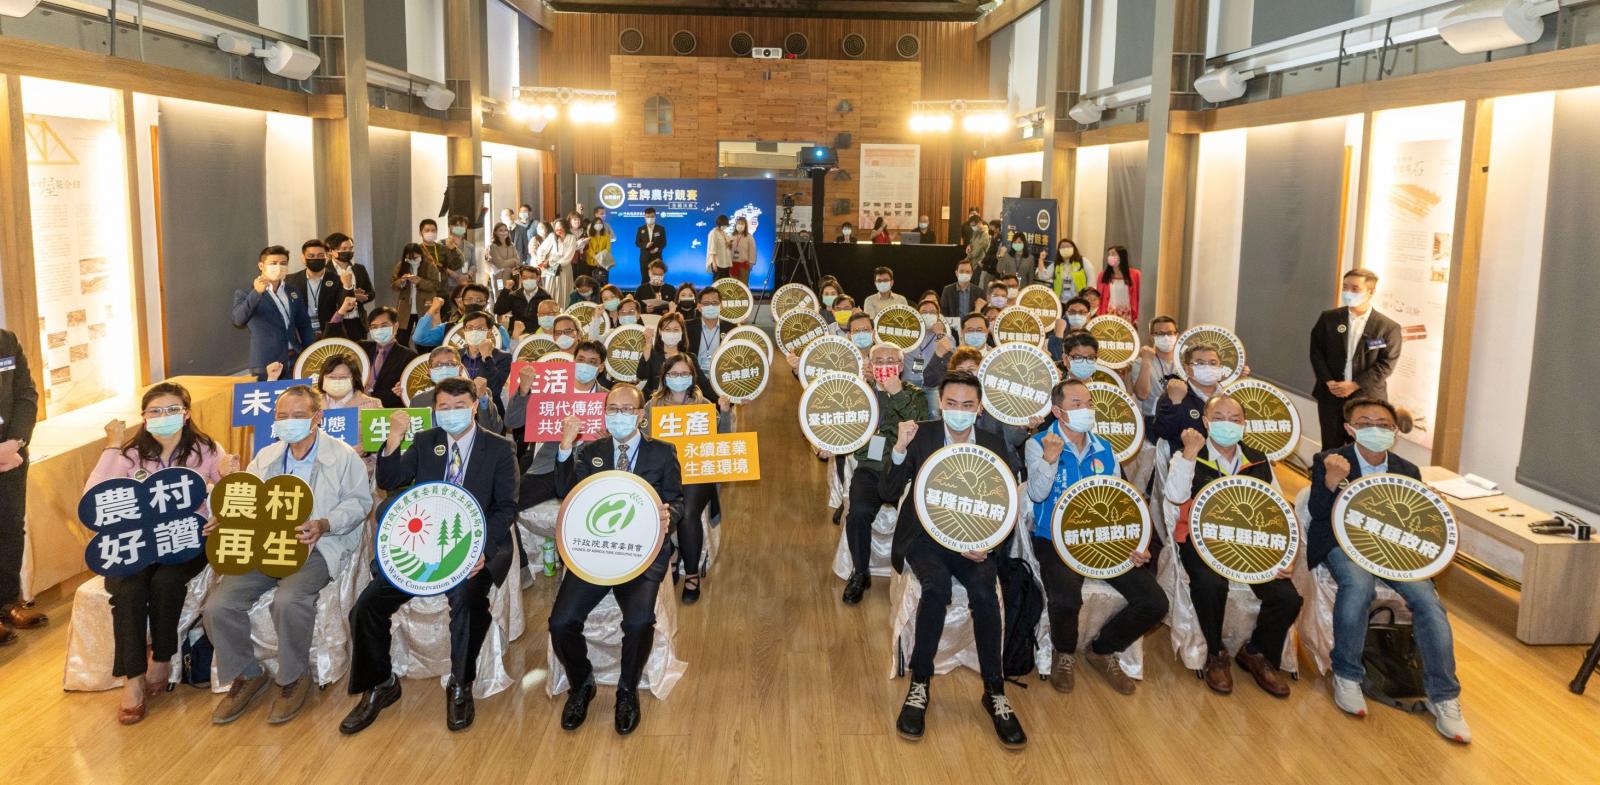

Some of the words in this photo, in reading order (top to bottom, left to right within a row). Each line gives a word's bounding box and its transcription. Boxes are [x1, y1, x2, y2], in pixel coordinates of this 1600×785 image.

[627, 188, 698, 200] 金牌農村競賽
[1008, 230, 1048, 246] 金村競賽
[612, 349, 643, 360] 金牌農
[1098, 340, 1134, 350] 南市政府
[722, 367, 760, 382] 金牌農村
[984, 374, 1048, 404] 南投縣政府
[539, 401, 604, 416] 現代傳統
[808, 410, 869, 426] 臺北市政府
[658, 410, 710, 438] 生產
[1092, 422, 1136, 435] 市政府
[684, 440, 748, 458] 永續產業
[684, 460, 749, 477] 生產環境
[94, 474, 194, 526] 農村
[220, 482, 304, 521] 農村
[926, 488, 1006, 522] 基隆市政府
[98, 516, 200, 570] 好讚
[930, 527, 957, 547] GOLDEN
[960, 541, 990, 550] VILLAGE
[1064, 523, 1140, 545] 新竹縣政府
[1202, 522, 1287, 551] 苗栗縣政府
[1345, 508, 1440, 560] 臺東縣政府
[216, 528, 298, 566] 再生
[572, 538, 642, 552] 行政院農業委員會
[1076, 564, 1104, 576] GOLDEN
[1212, 560, 1240, 579] GOLDEN
[1244, 571, 1275, 580] VILLAGE
[1347, 545, 1374, 570] GOLDEN
[1378, 568, 1414, 578] VILLAGE
[388, 566, 405, 584] Water
[406, 580, 450, 591] Conservation
